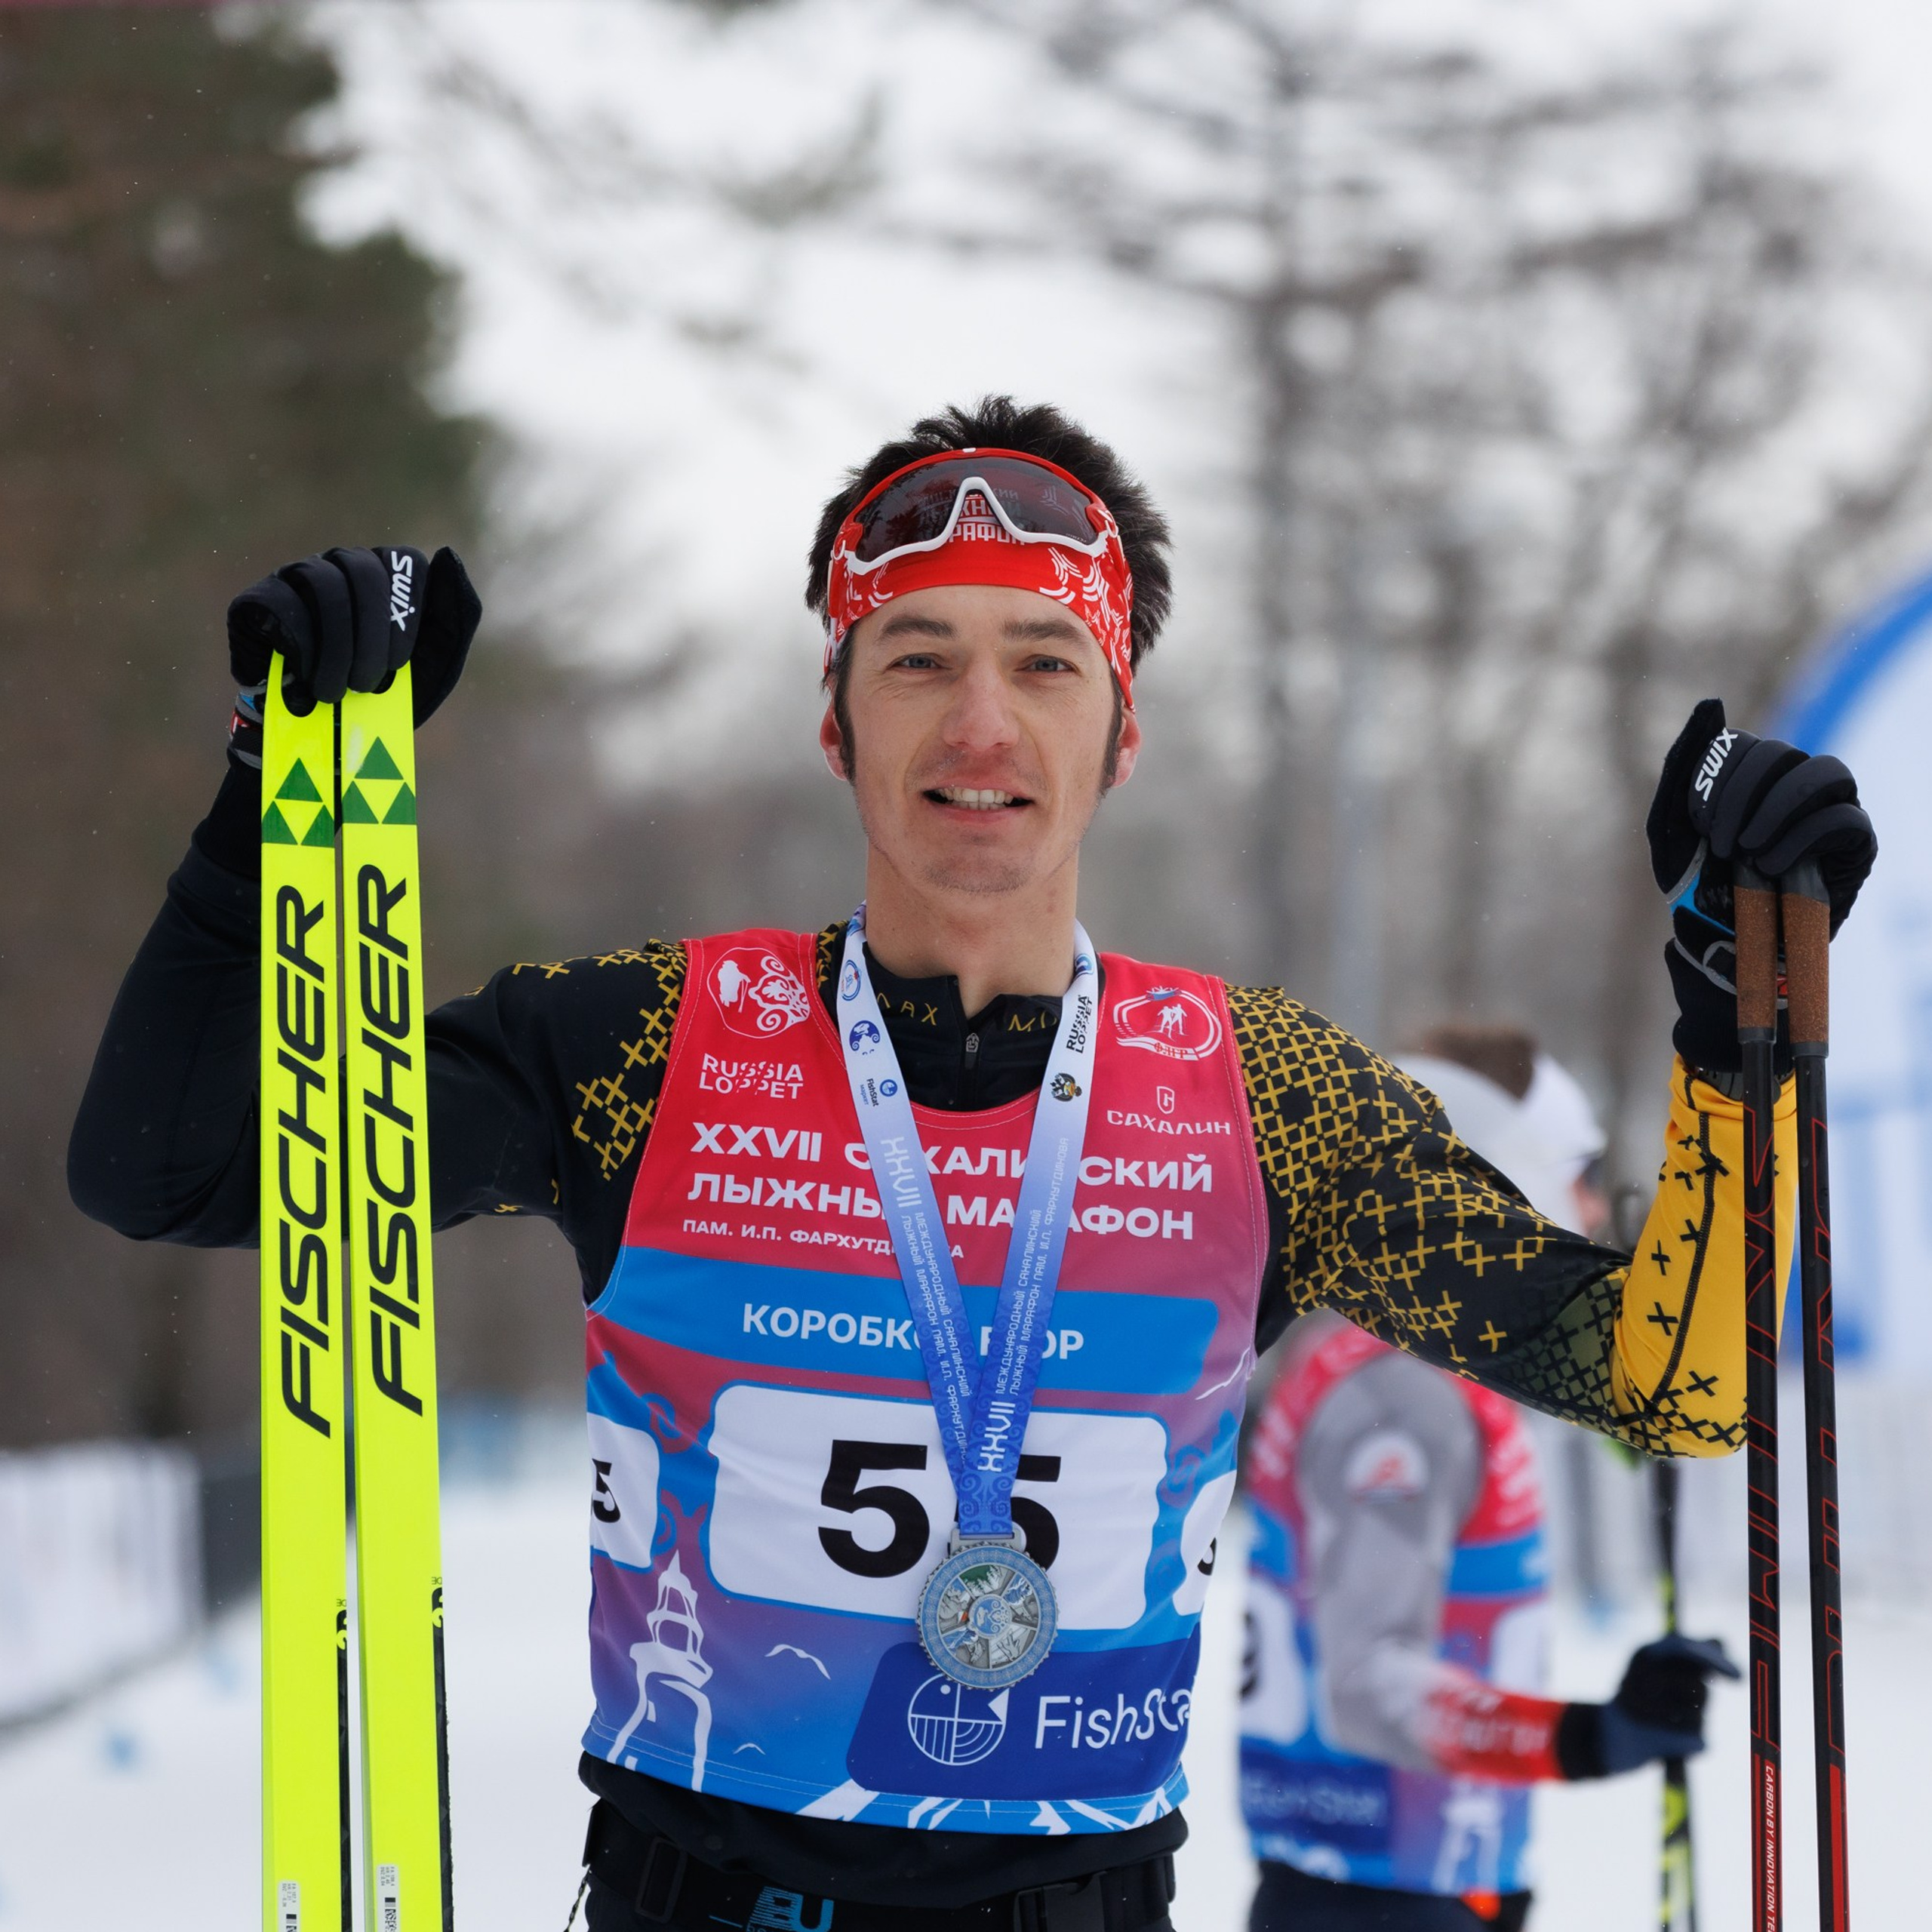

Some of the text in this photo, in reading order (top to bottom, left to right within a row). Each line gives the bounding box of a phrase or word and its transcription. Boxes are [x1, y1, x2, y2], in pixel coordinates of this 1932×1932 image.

[1066, 994, 1088, 1051] RUSSIA
[699, 1071, 804, 1100] LOPPET
[702, 1053, 804, 1081] RUSSIA
[357, 863, 423, 1417] FISCHER
[690, 1122, 823, 1162] XXVII
[1106, 1109, 1231, 1135] САХАЛИН
[276, 884, 331, 1439] FISCHER
[881, 1136, 922, 1208] XXVII
[683, 1220, 734, 1237] ПАМ.
[741, 1225, 781, 1241] И.П.
[977, 1401, 1017, 1472] XXVII
[1764, 1765, 1774, 1817] CARBON
[1766, 1818, 1774, 1838] BY
[1766, 1838, 1776, 1913] INNOVATION
